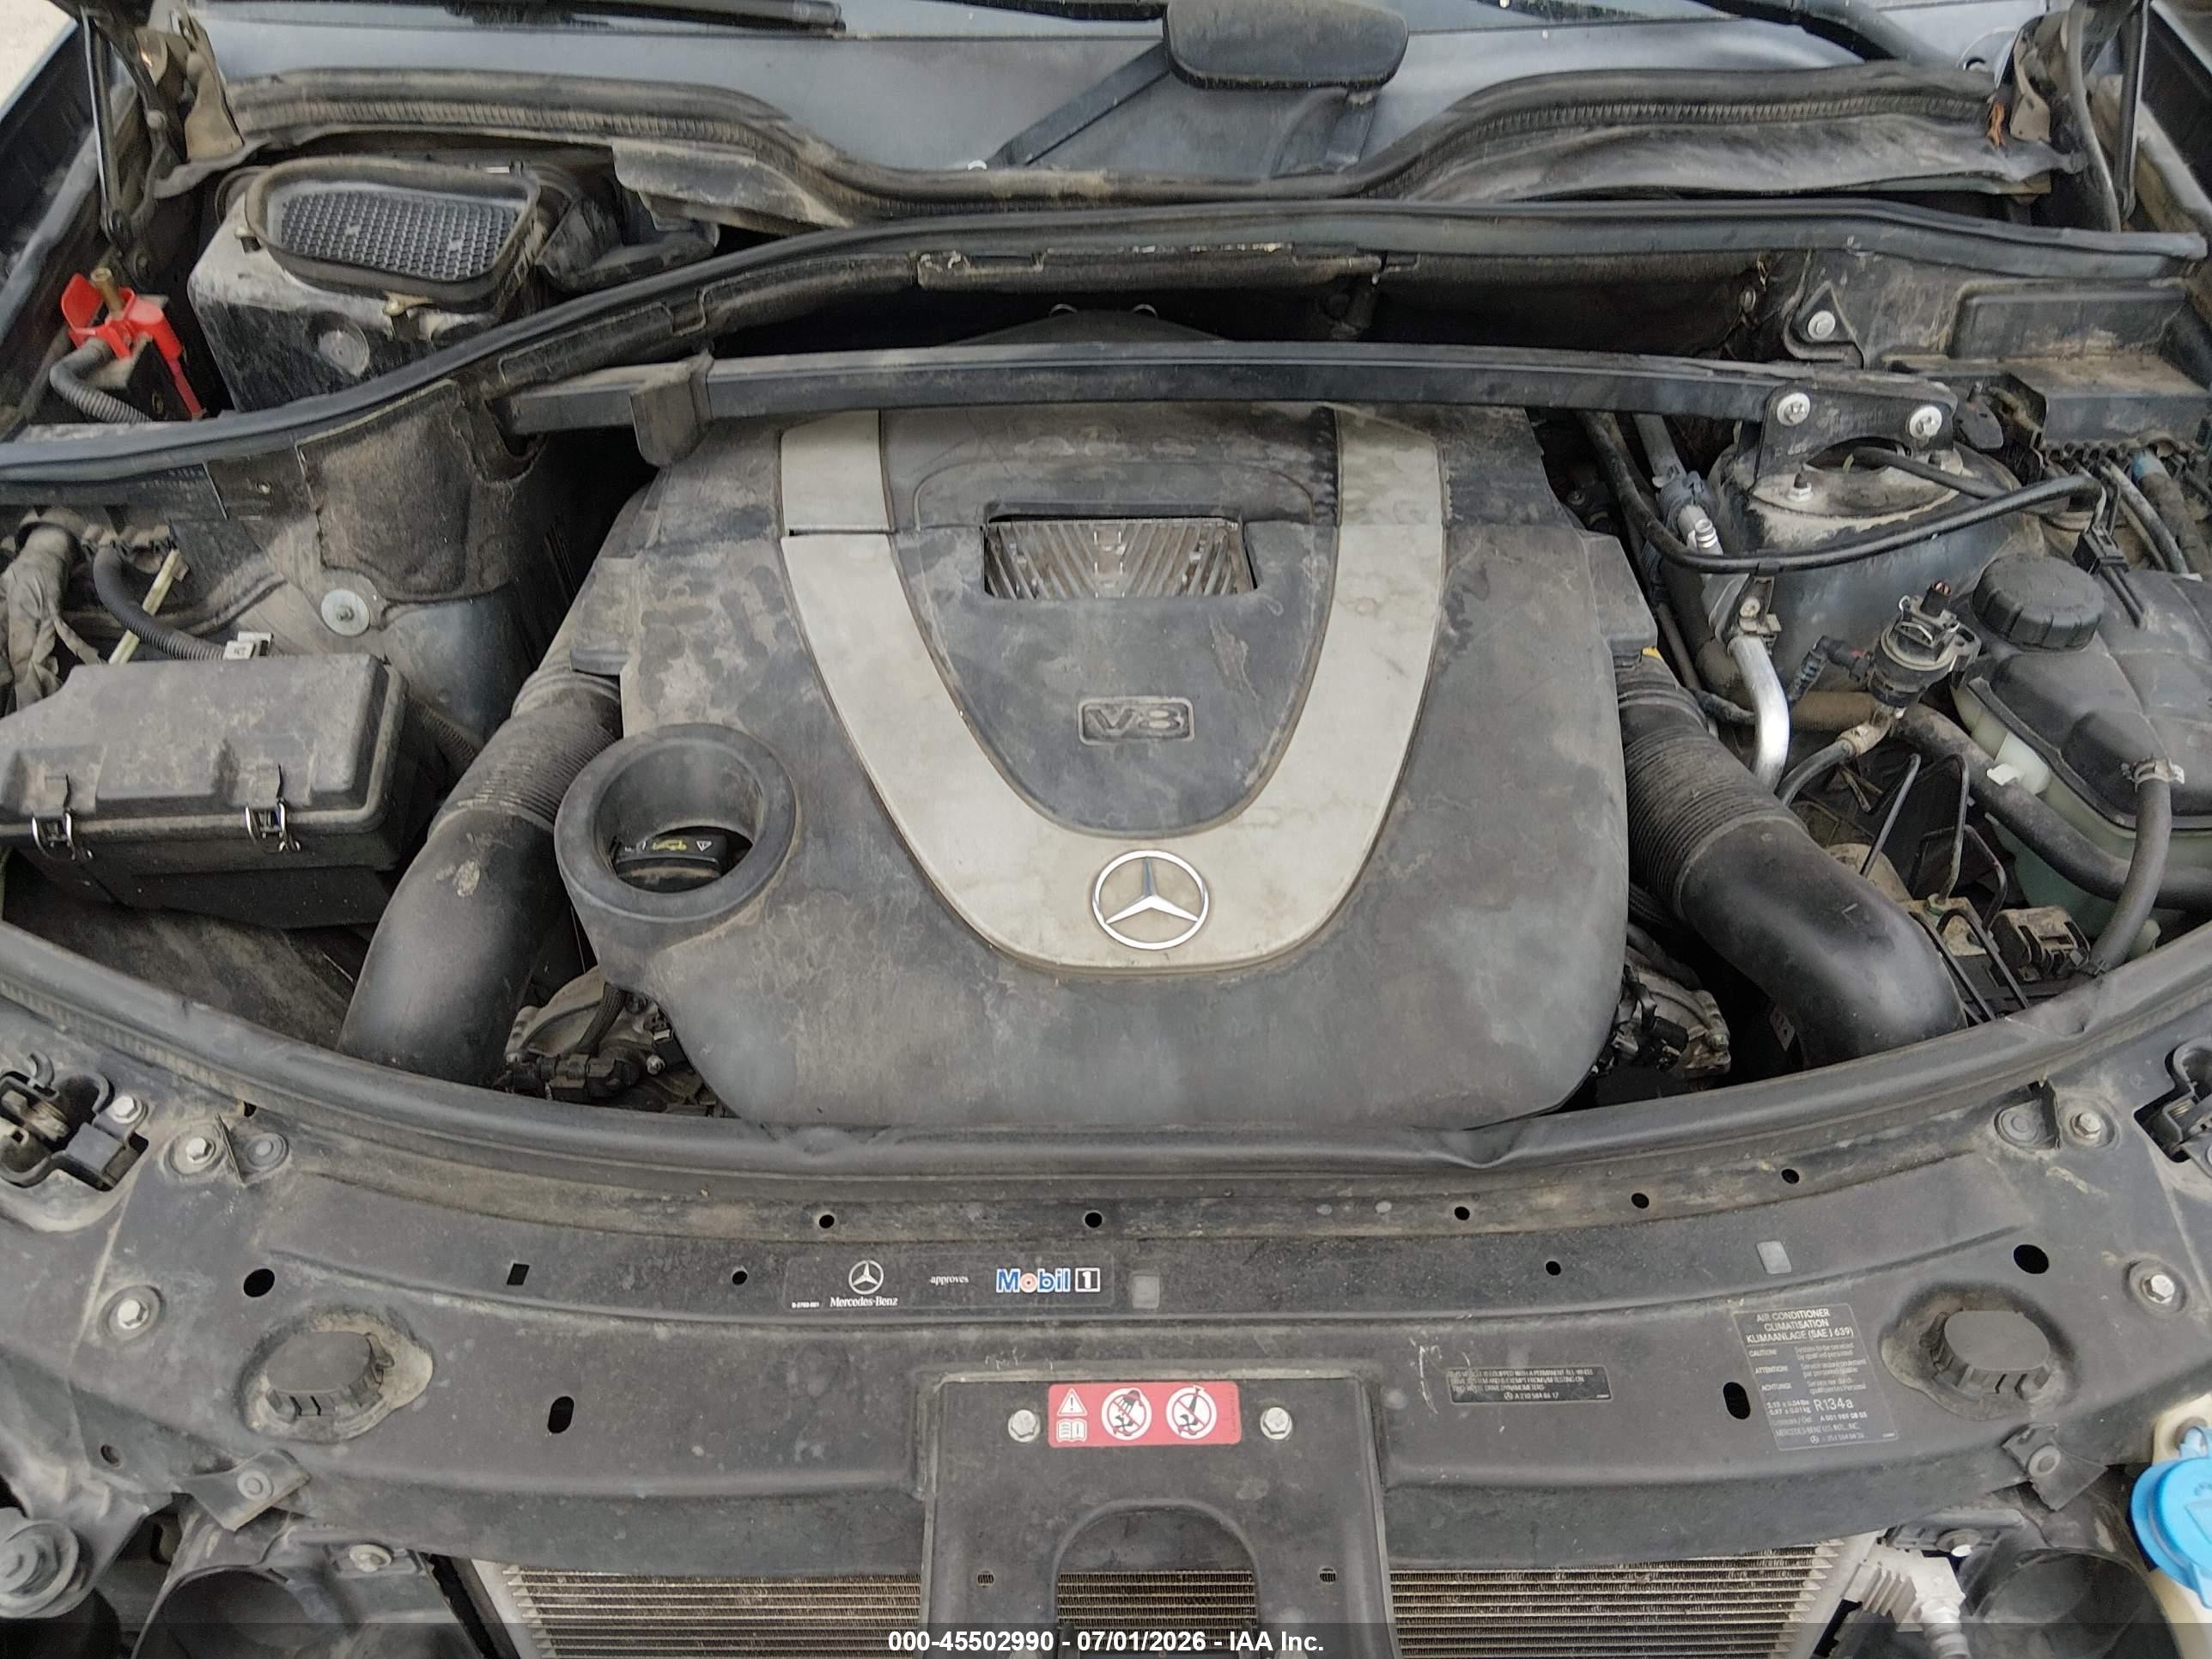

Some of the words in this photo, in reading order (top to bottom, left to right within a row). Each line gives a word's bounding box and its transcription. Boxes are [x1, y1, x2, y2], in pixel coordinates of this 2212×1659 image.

[929, 1275, 969, 1286] approves
[996, 1267, 1071, 1292] Mobil
[830, 1296, 898, 1308] Mercedes-Benz
[1757, 1313, 1771, 1322] AIR
[1771, 1308, 1831, 1321] CONDITIONER
[1764, 1318, 1830, 1332] CLIMATISATION
[1745, 1330, 1807, 1344] KLIMAANLAGE
[1813, 1397, 1855, 1412] R134a
